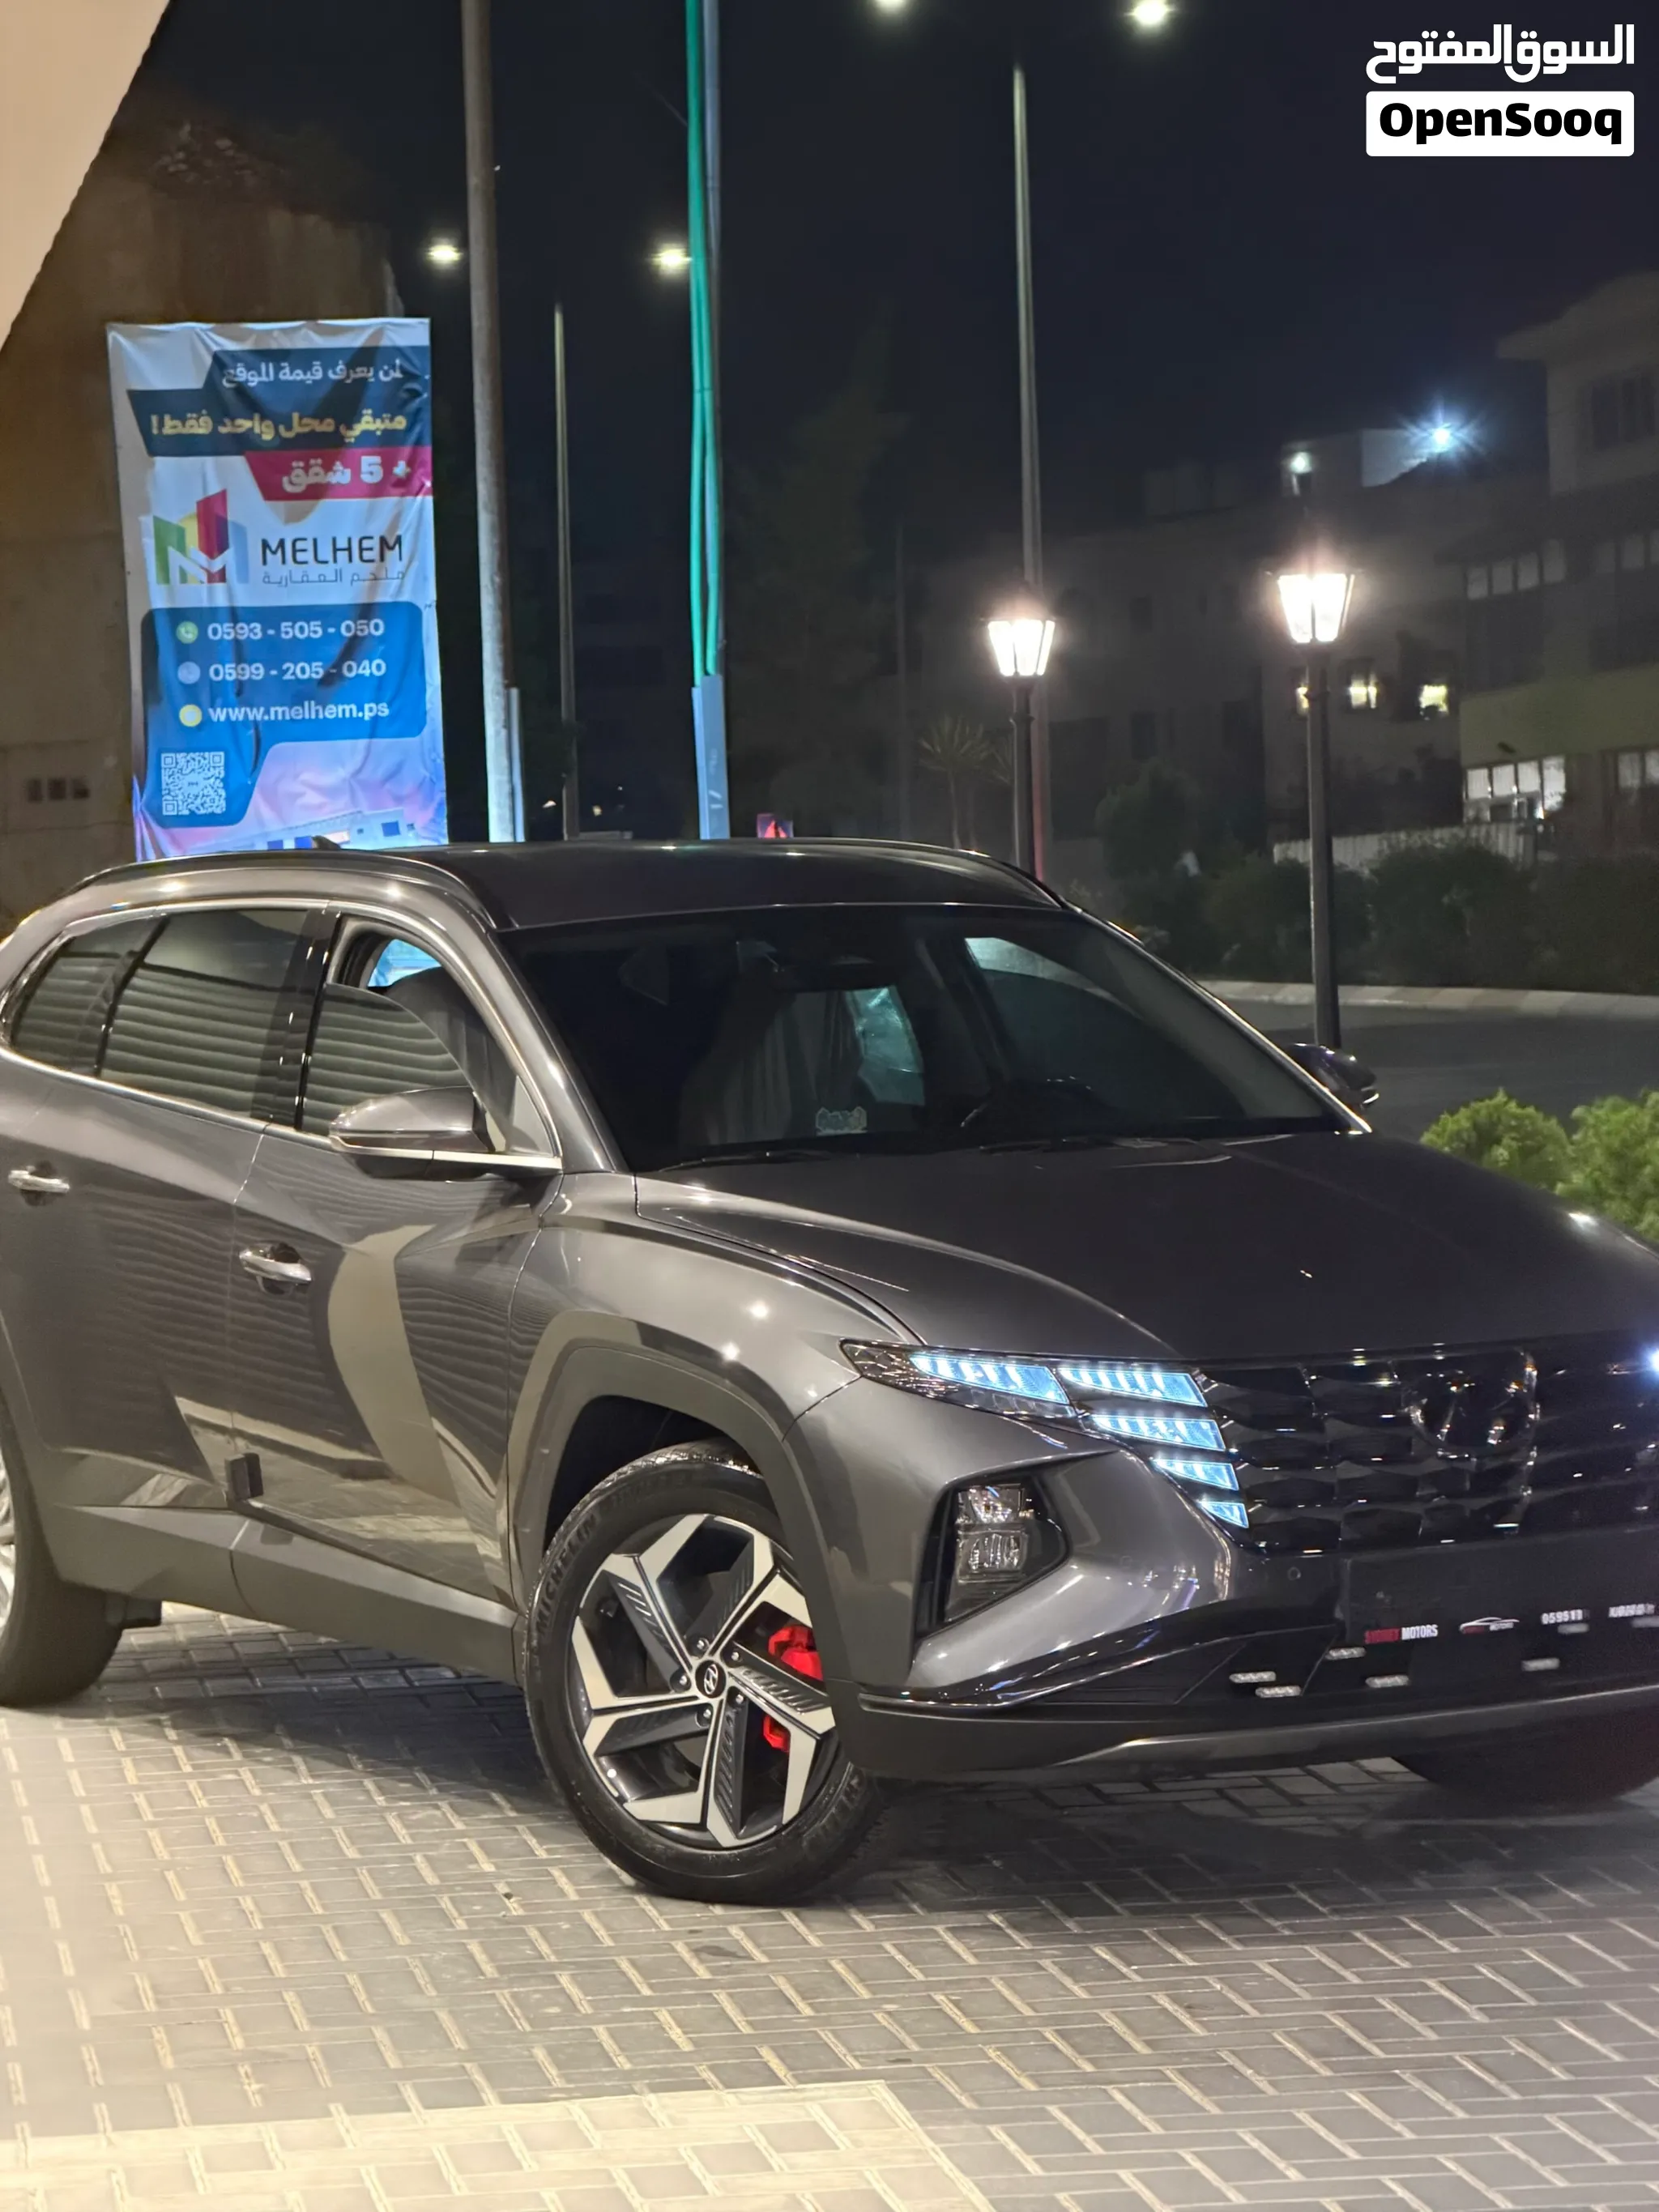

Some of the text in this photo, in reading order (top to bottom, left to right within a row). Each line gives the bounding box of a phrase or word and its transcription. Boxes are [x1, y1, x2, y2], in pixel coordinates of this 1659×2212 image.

[222, 361, 275, 388] الموقع
[279, 361, 323, 385] قيمة
[327, 360, 374, 384] يعرف
[217, 413, 275, 441] واحد
[278, 412, 335, 438] محل
[339, 407, 407, 444] متبقي
[282, 458, 352, 493] شقق
[360, 455, 383, 484] 5
[260, 534, 403, 566] MELHEM
[262, 566, 406, 589] ملحم العقارية
[207, 622, 263, 641] 0593
[279, 621, 323, 639] 505
[339, 619, 385, 637] 050
[208, 663, 265, 682] 0599
[282, 662, 324, 680] 205
[341, 659, 386, 678] 040
[207, 700, 390, 722] www.melhem.ps
[535, 1512, 601, 1637] MICHELIN
[1401, 1623, 1439, 1641] MOTORS
